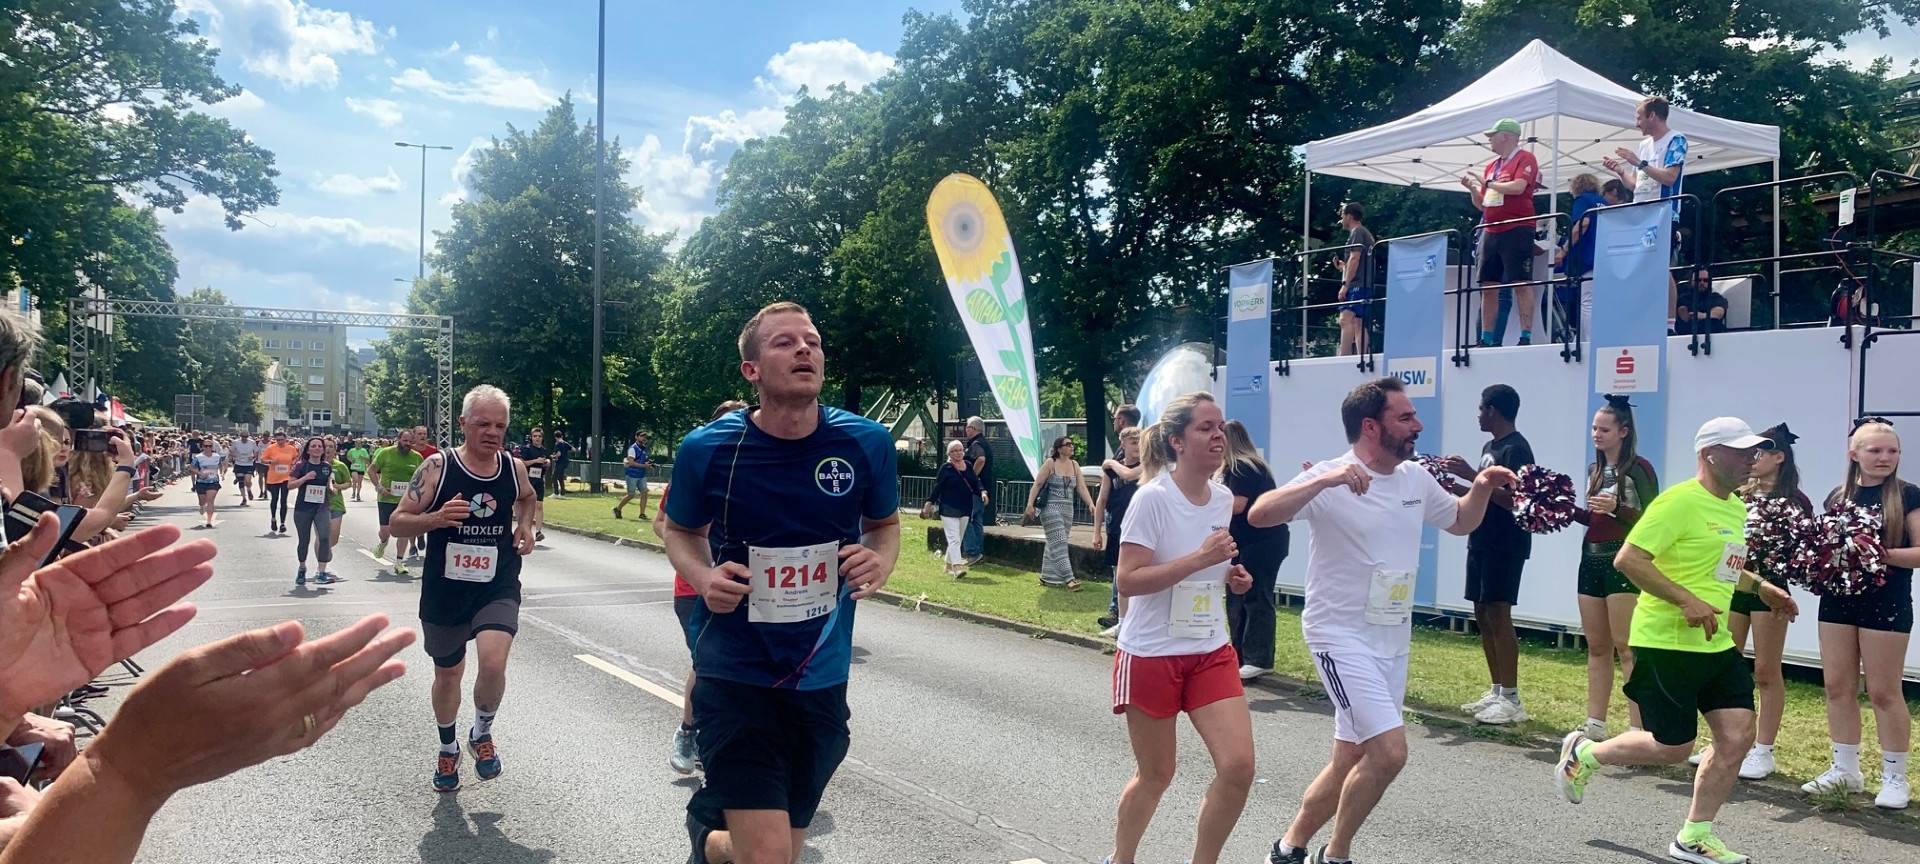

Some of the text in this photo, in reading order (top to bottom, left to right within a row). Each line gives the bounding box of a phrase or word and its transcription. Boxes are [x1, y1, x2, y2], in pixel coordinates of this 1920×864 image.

[819, 472, 852, 480] BAYER
[831, 460, 840, 494] BAYER
[458, 525, 504, 535] TROXLER
[453, 554, 490, 570] 1343
[764, 561, 827, 589] 1214
[1389, 583, 1409, 601] 20
[805, 604, 828, 618] 1214
[1192, 594, 1211, 613] 21
